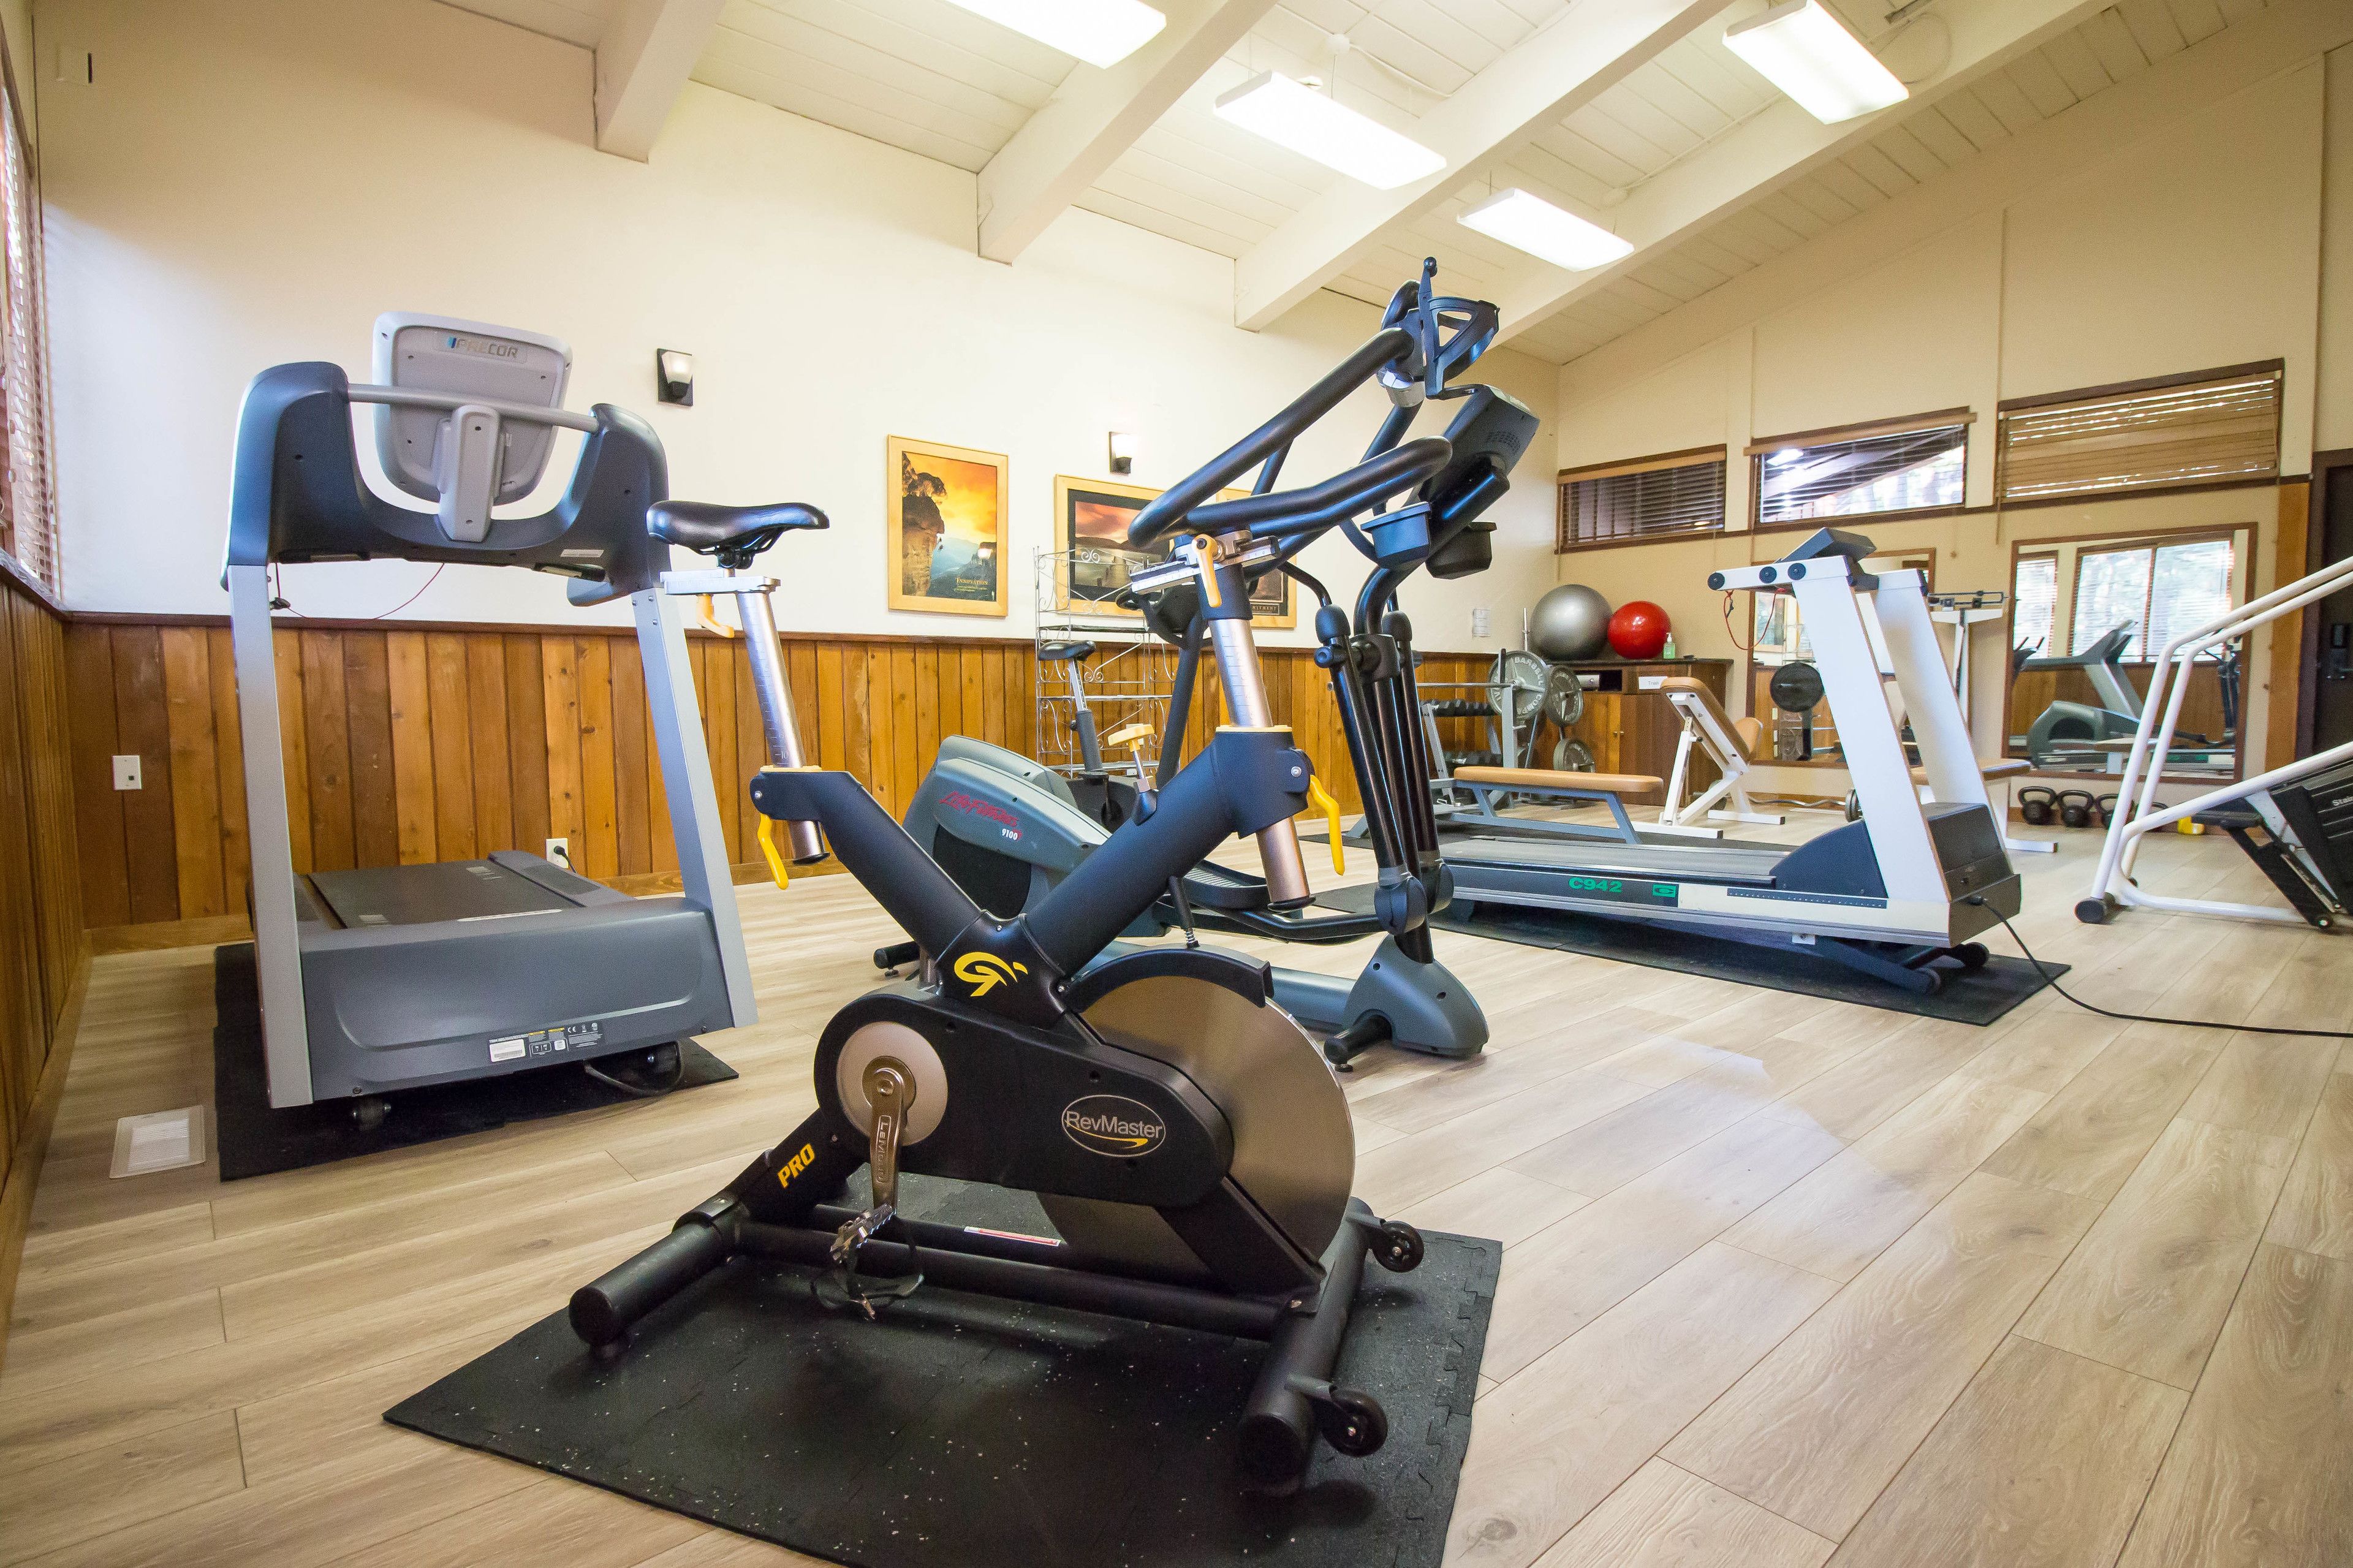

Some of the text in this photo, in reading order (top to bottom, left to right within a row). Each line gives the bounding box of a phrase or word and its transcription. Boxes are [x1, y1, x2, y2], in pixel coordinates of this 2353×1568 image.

[1001, 828, 1018, 841] 9100
[1568, 877, 1623, 893] C942
[1066, 1110, 1163, 1138] RevMaster
[776, 1143, 815, 1188] PRO
